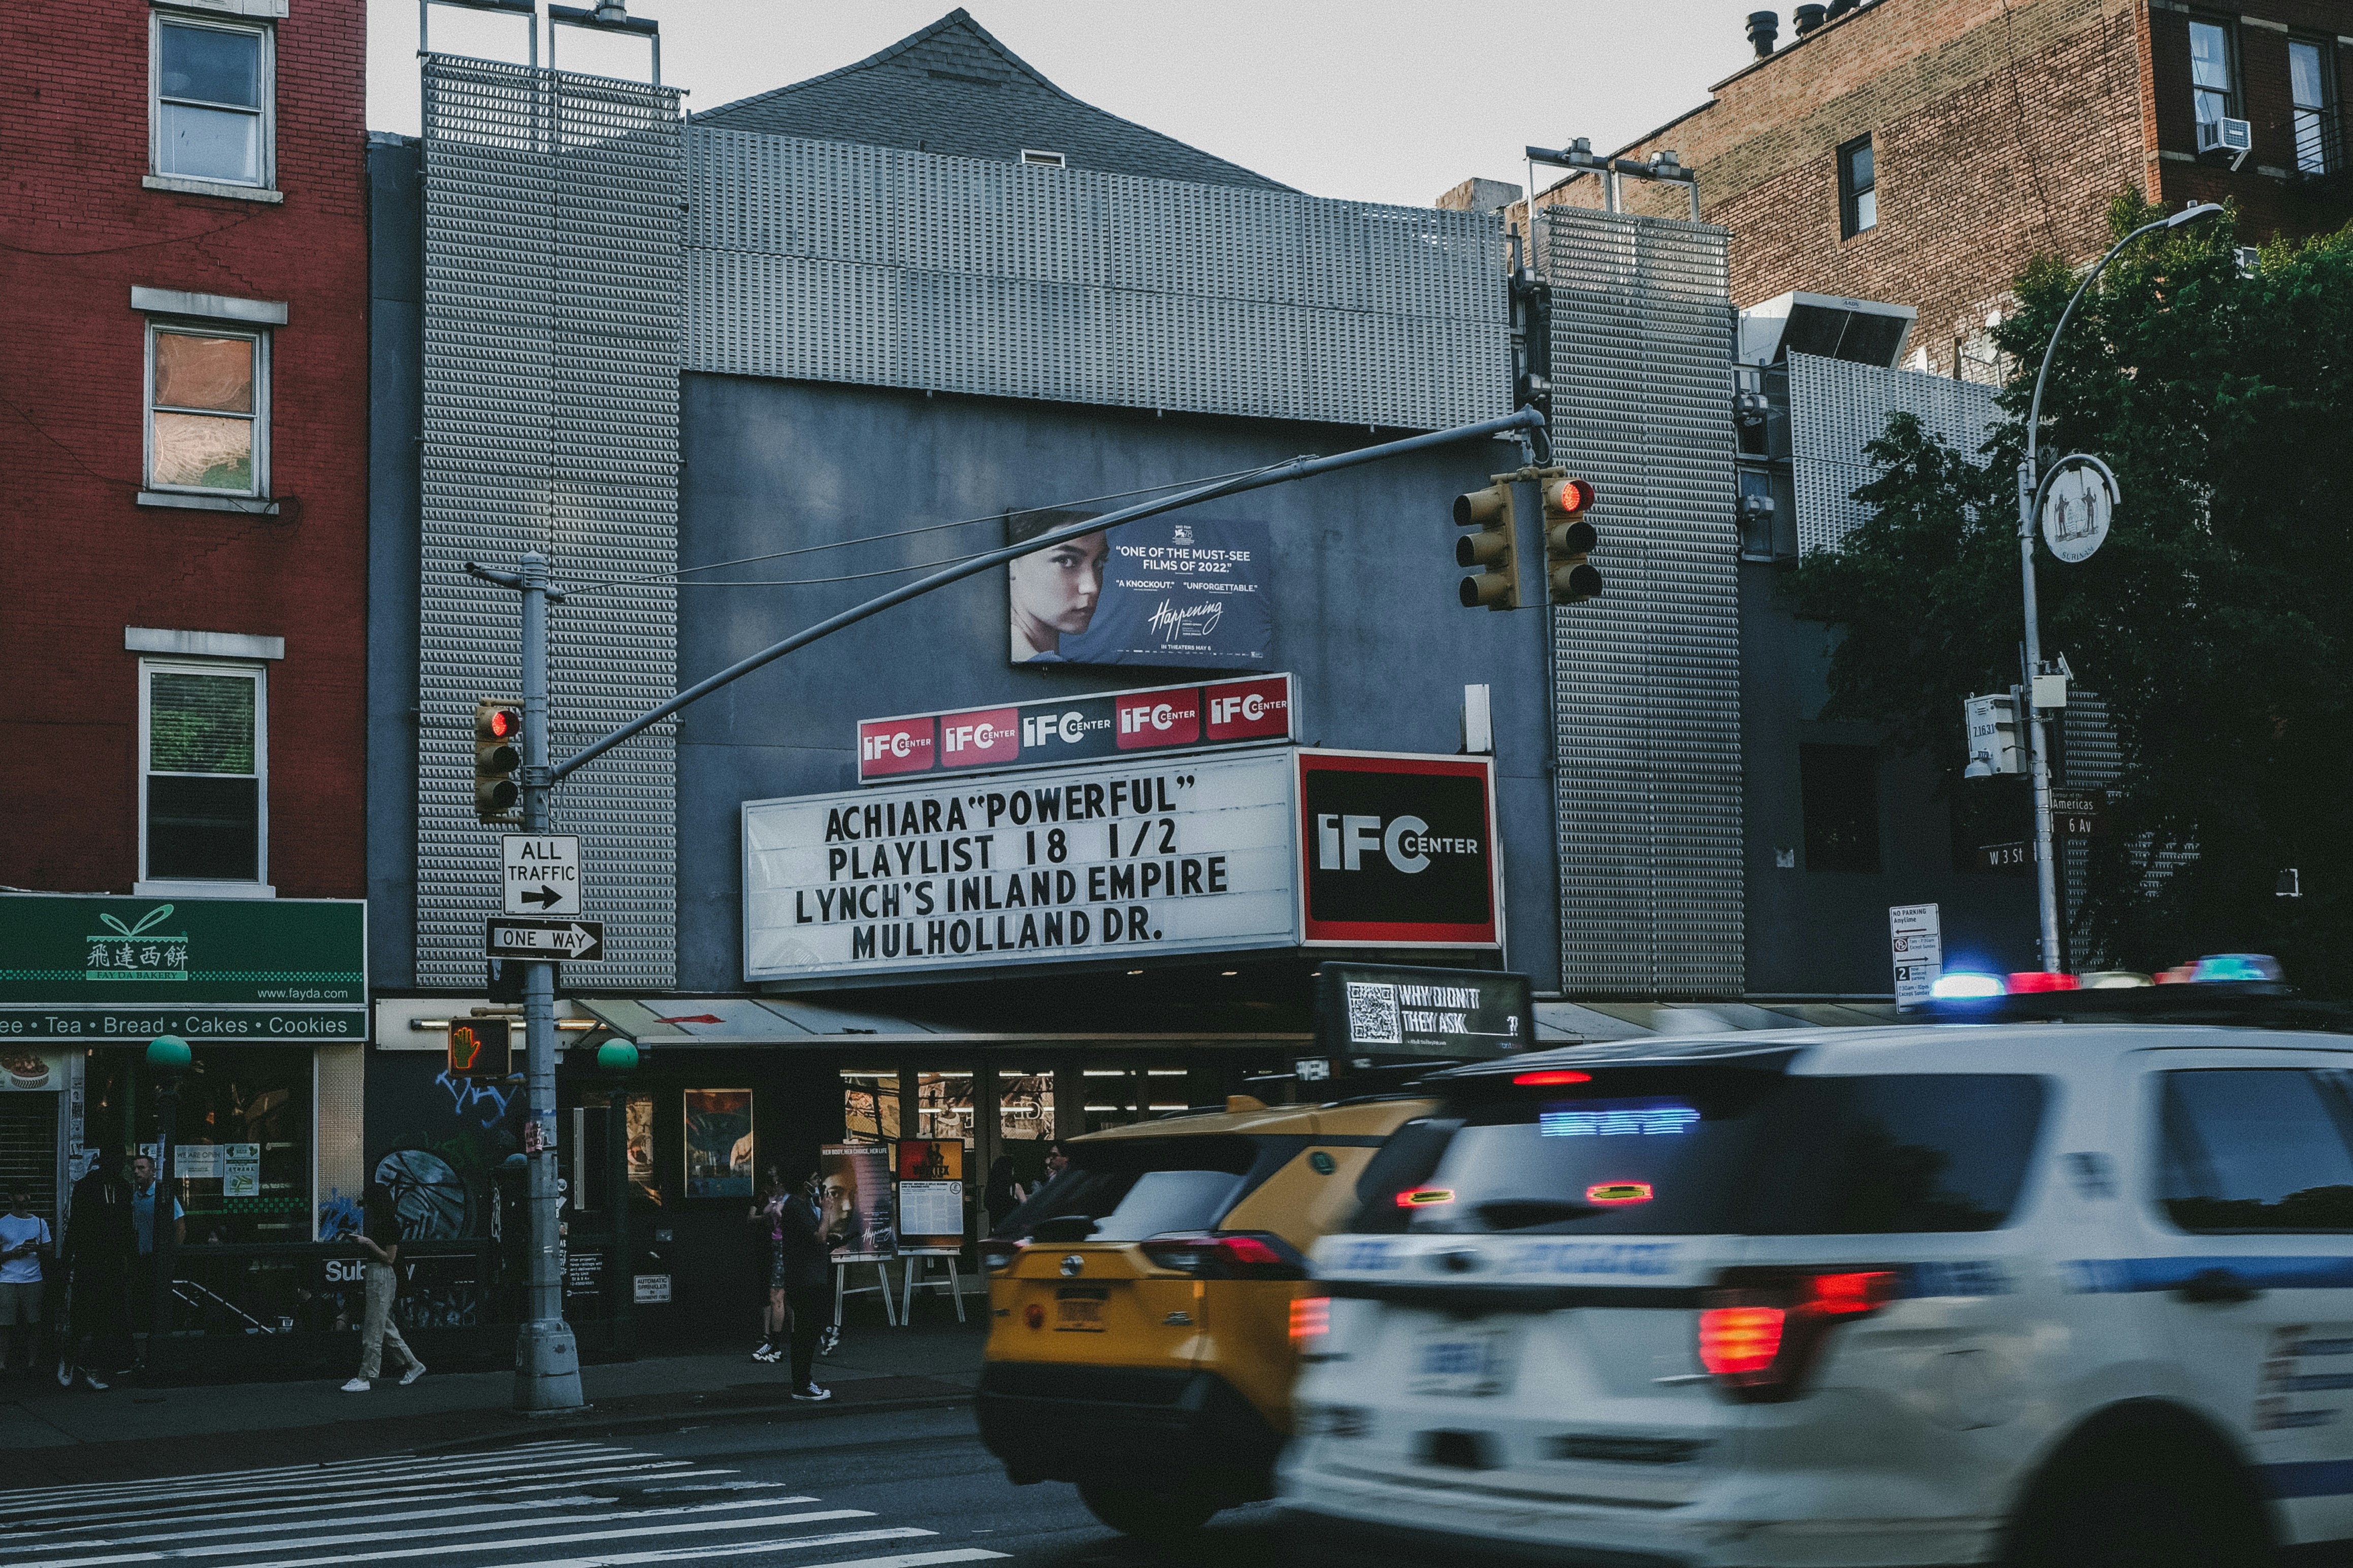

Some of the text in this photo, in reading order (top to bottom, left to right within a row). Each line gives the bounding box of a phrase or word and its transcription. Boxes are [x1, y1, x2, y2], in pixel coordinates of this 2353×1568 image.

[1184, 529, 1193, 538] 78
[1116, 545, 1250, 561] "ONE OF THE MUST-SEE
[1143, 559, 1178, 571] FILMS
[1180, 560, 1196, 571] OF
[1116, 579, 1125, 587] "A
[1148, 598, 1224, 642] Happening
[1251, 700, 1287, 712] CENTER
[1160, 710, 1195, 721] CENTER
[1070, 719, 1111, 732] CENTER
[1973, 723, 1995, 737] 71631
[982, 729, 1016, 740] CENTER
[899, 738, 931, 749] CENTER
[2053, 798, 2093, 810] Americas
[825, 796, 968, 843] ACHIARA
[2069, 818, 2091, 832] 6 Av
[520, 841, 562, 860] ALL
[829, 817, 1176, 881] PLAYLIST 18 1/2
[1404, 837, 1478, 854] CENTER
[1989, 847, 2023, 865] W 3 St
[508, 865, 575, 881] TRAFFIC
[796, 855, 1228, 924] LYNCH'S INLAND EMPIRE
[503, 930, 586, 949] ONE WAY
[853, 906, 1163, 960] MULHOLLAND DR.
[87, 942, 188, 971] 飛達西餅
[137, 972, 177, 980] BAKERY
[1899, 968, 1906, 980] 2
[257, 988, 348, 1001] www.fayda.com
[1398, 984, 1432, 1007] WHY
[45, 1017, 81, 1033] Tea
[105, 1017, 164, 1033] Bread
[185, 1016, 248, 1033] Cakes
[269, 1017, 347, 1033] Cookies
[1401, 1010, 1438, 1033] THEY
[1439, 1012, 1469, 1034] ASK
